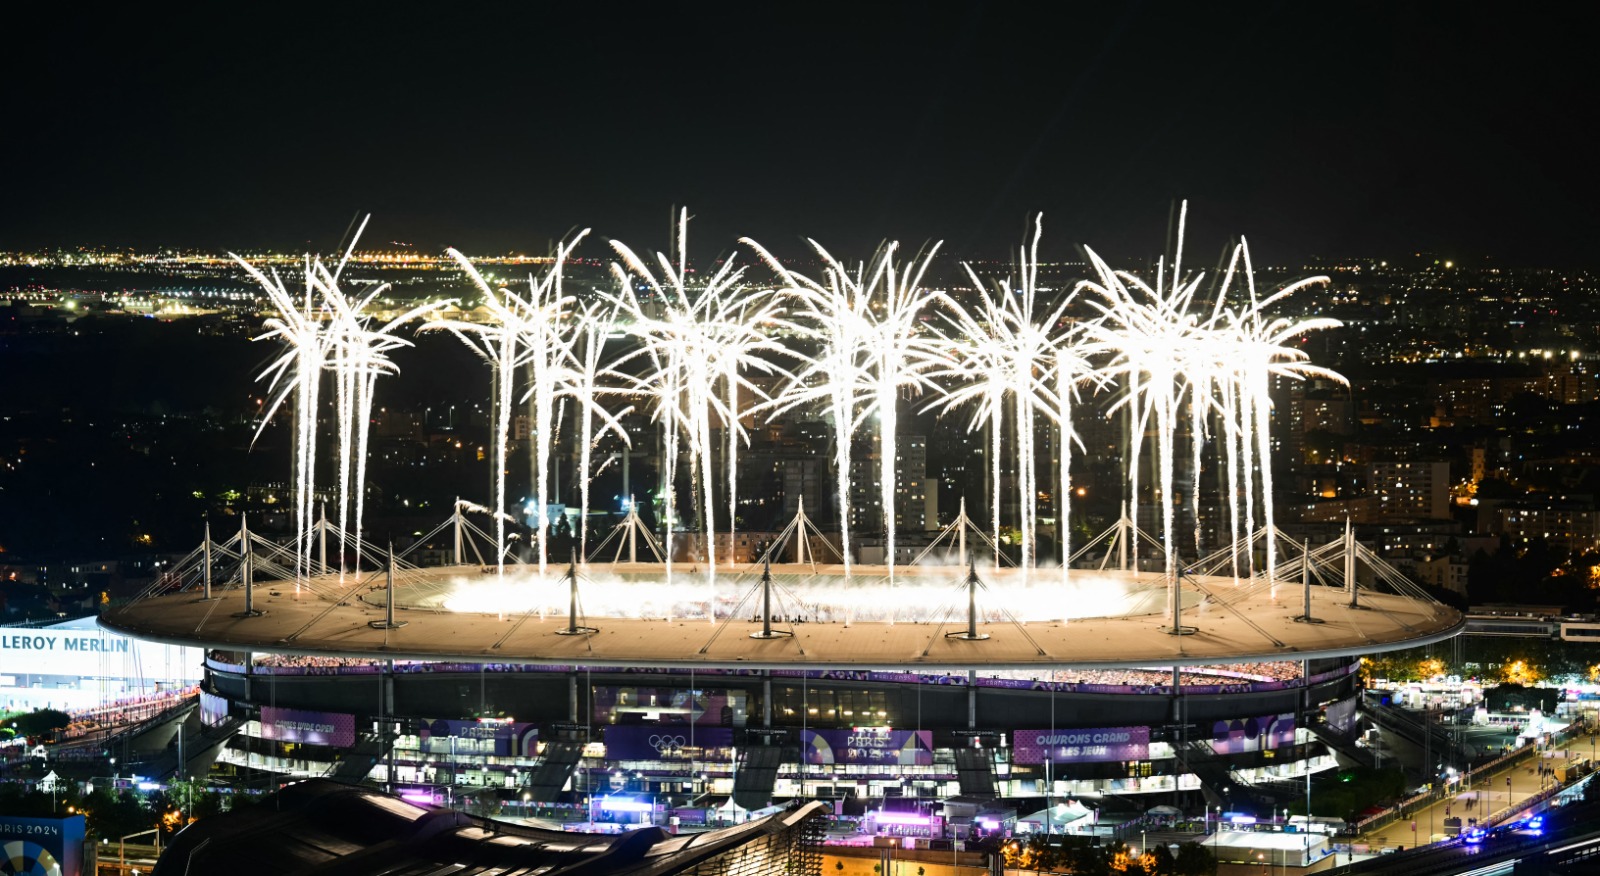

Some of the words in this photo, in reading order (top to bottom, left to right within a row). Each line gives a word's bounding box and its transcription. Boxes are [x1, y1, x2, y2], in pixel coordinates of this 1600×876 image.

[2, 635, 57, 650] LEROY
[64, 637, 128, 652] MERLIN
[297, 721, 314, 731] WIDE
[315, 723, 335, 733] OPEN
[461, 726, 495, 738] PARIS
[847, 735, 885, 748] PARIS
[1036, 734, 1091, 745] OUVRONS
[1093, 732, 1131, 744] GRAND
[1061, 746, 1080, 757] LES
[1081, 745, 1107, 756] JEUX
[26, 825, 58, 836] 2024
